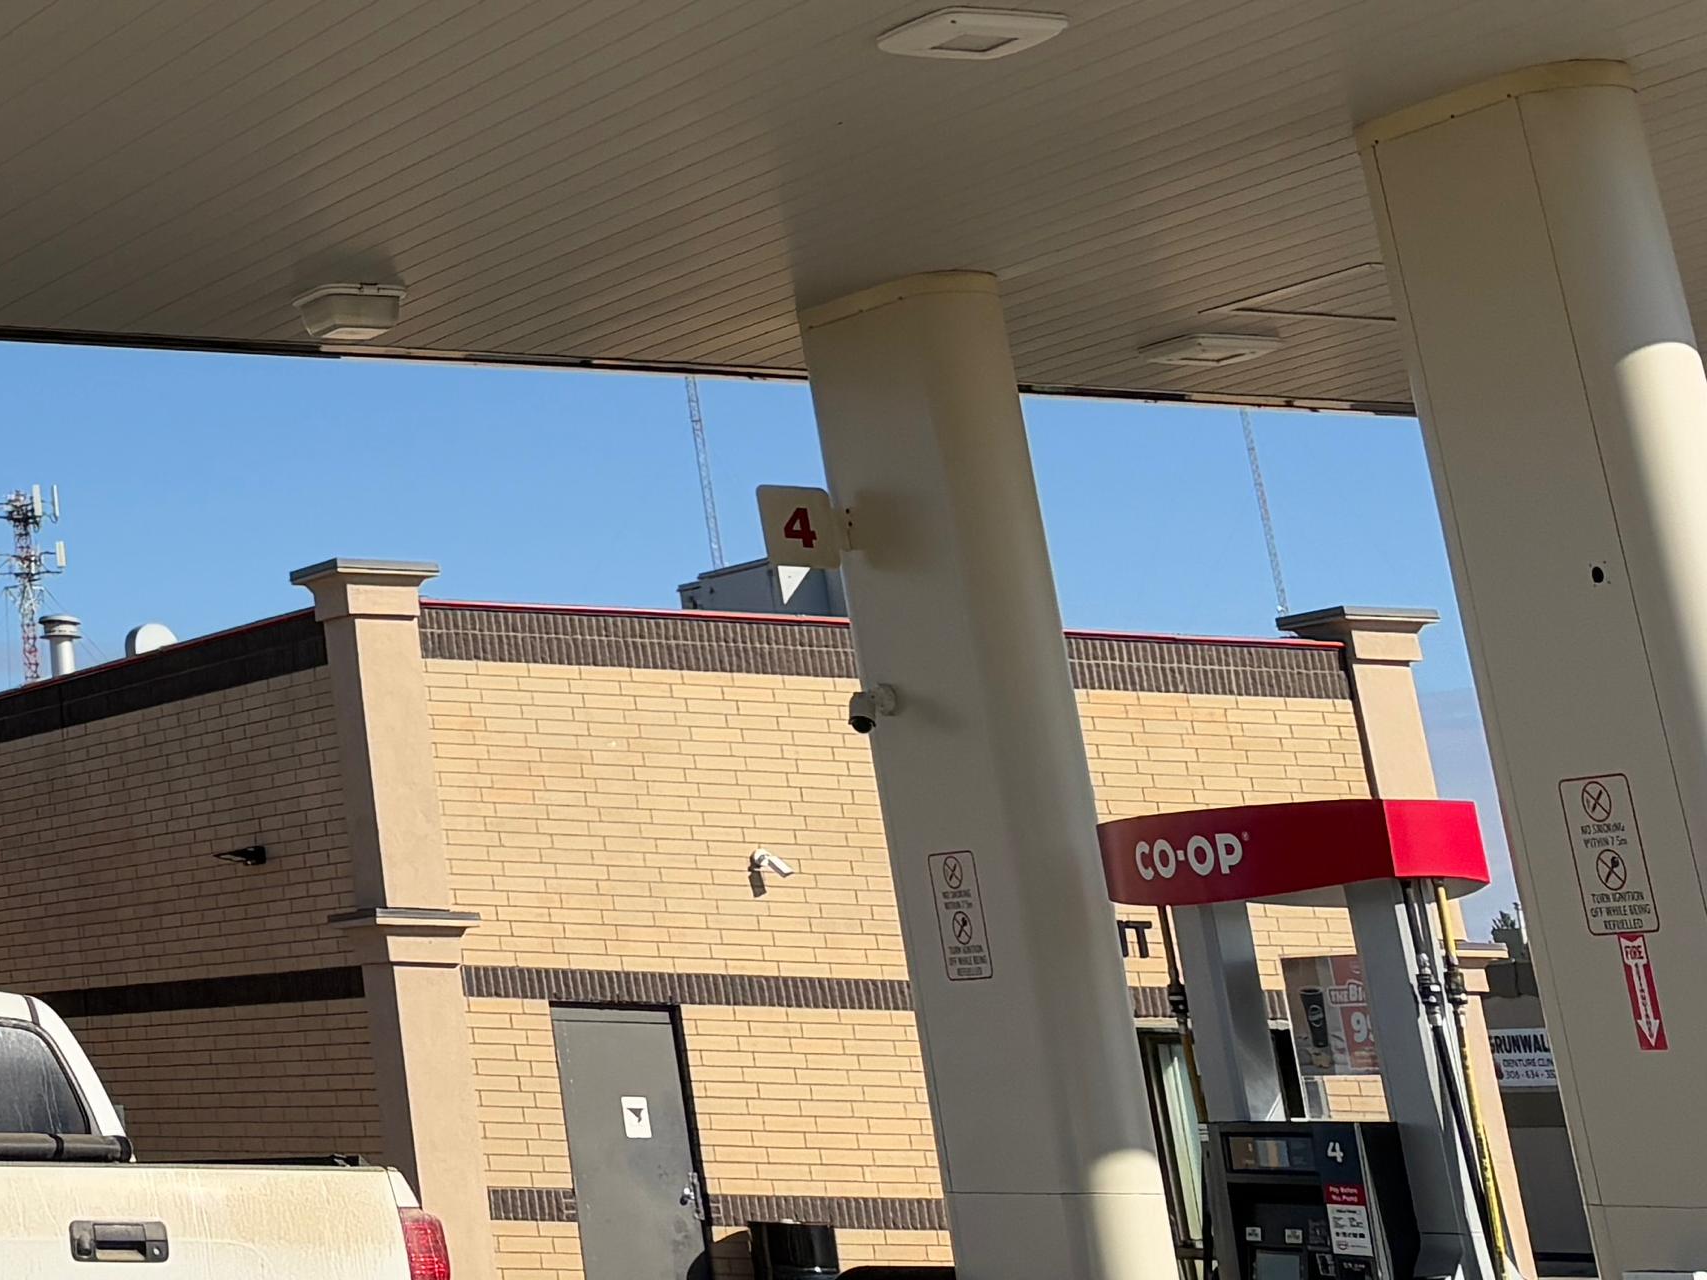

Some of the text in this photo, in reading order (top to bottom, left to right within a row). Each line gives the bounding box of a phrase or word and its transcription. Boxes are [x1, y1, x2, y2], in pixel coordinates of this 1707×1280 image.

[783, 507, 817, 549] 4
[1135, 833, 1243, 881] CO-OP
[1326, 1141, 1344, 1163] 4
